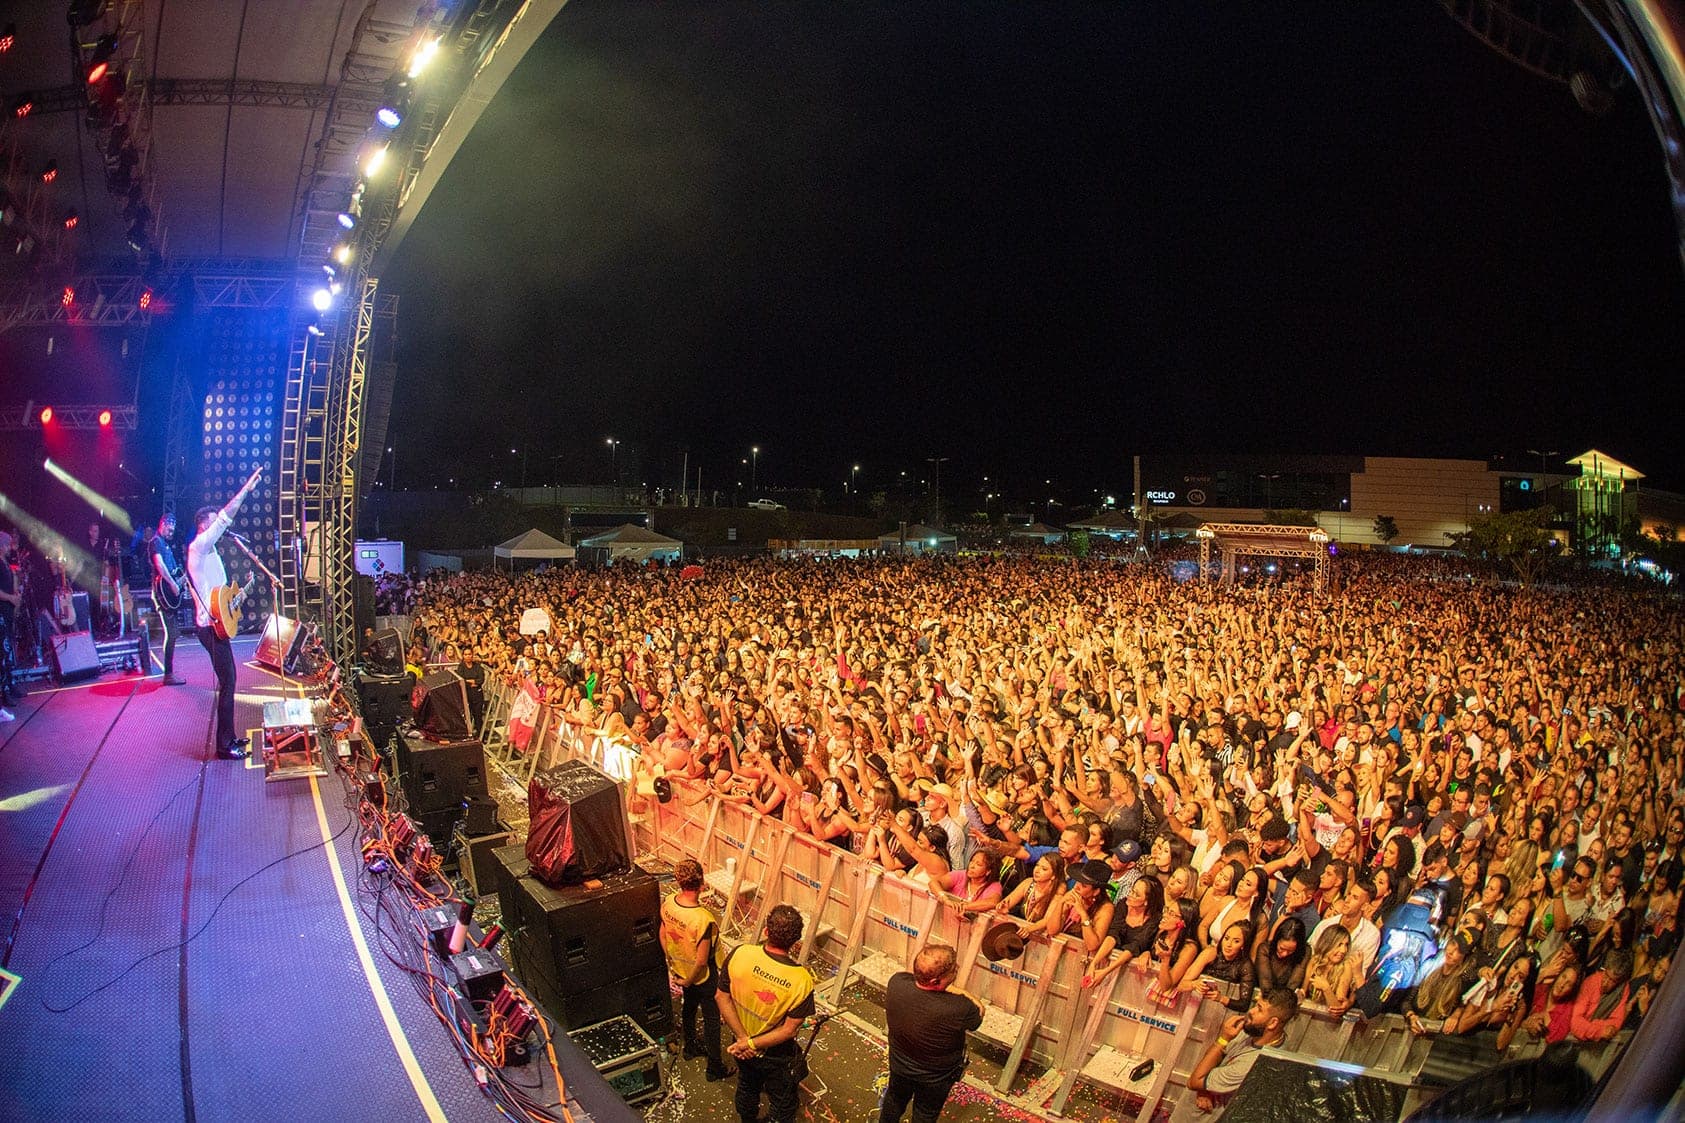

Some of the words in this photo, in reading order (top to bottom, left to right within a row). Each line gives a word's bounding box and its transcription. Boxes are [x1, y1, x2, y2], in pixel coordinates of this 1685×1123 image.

[1146, 491, 1176, 500] RCHLO
[883, 916, 898, 929] FULL
[752, 965, 792, 989] Rezende
[990, 963, 1009, 977] FULL
[1117, 1007, 1137, 1020] FULL
[1139, 1015, 1177, 1032] SERVICE
